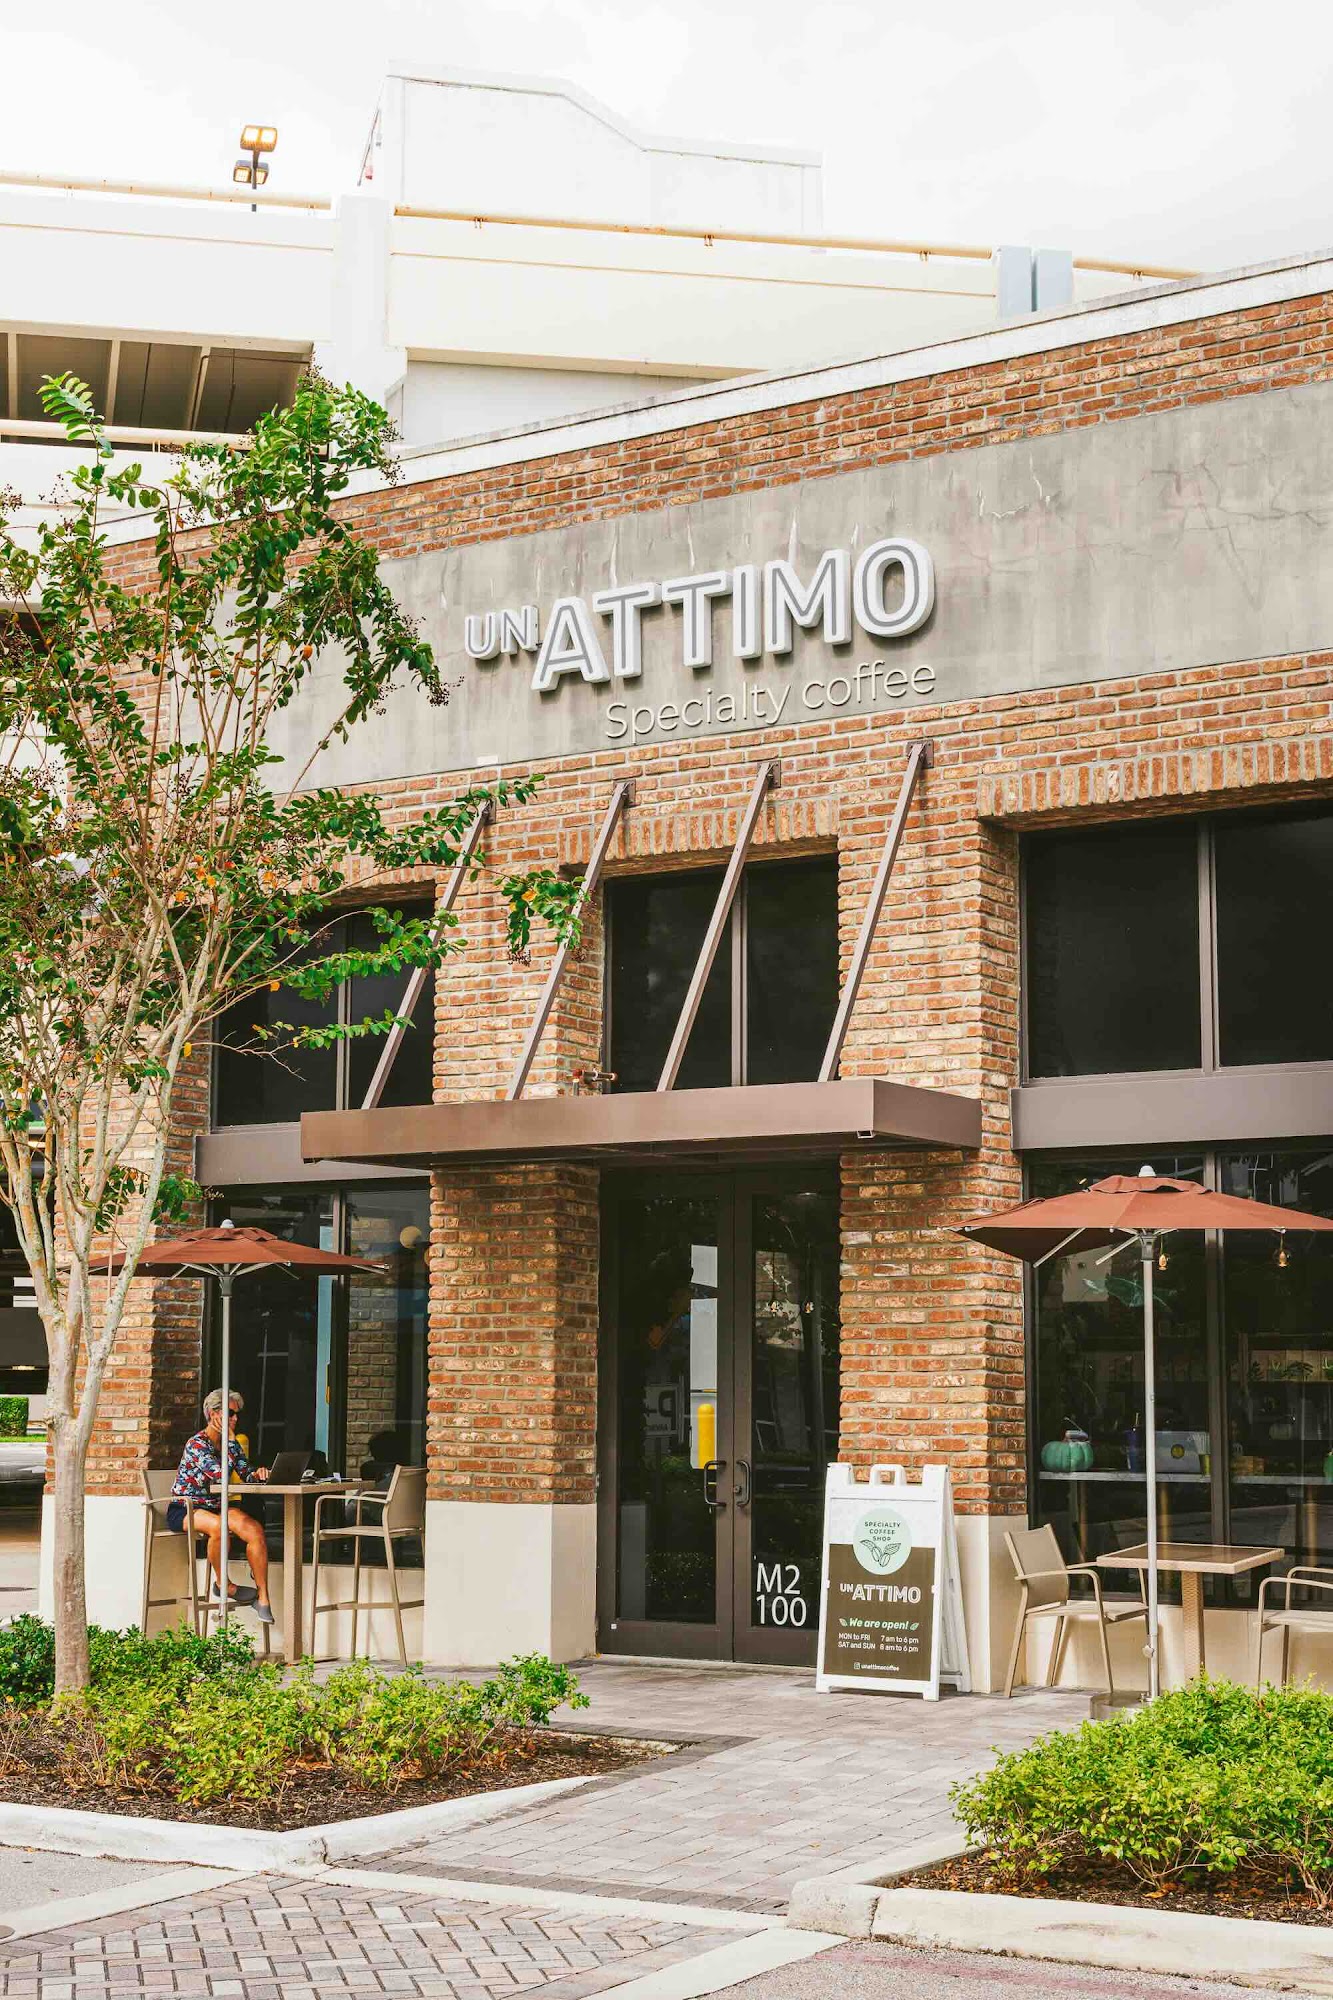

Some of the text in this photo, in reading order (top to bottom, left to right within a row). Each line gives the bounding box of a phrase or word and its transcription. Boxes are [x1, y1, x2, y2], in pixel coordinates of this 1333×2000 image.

[464, 537, 936, 692] UN ATTIMO
[605, 660, 936, 744] Specialty coffee
[756, 1562, 801, 1595] M2
[840, 1583, 921, 1604] UN ATTIMO
[756, 1594, 807, 1627] 100
[849, 1617, 909, 1631] We are open!
[838, 1632, 852, 1640] MON
[861, 1633, 871, 1641] FRI
[838, 1641, 850, 1649] SAT
[850, 1641, 862, 1649] and
